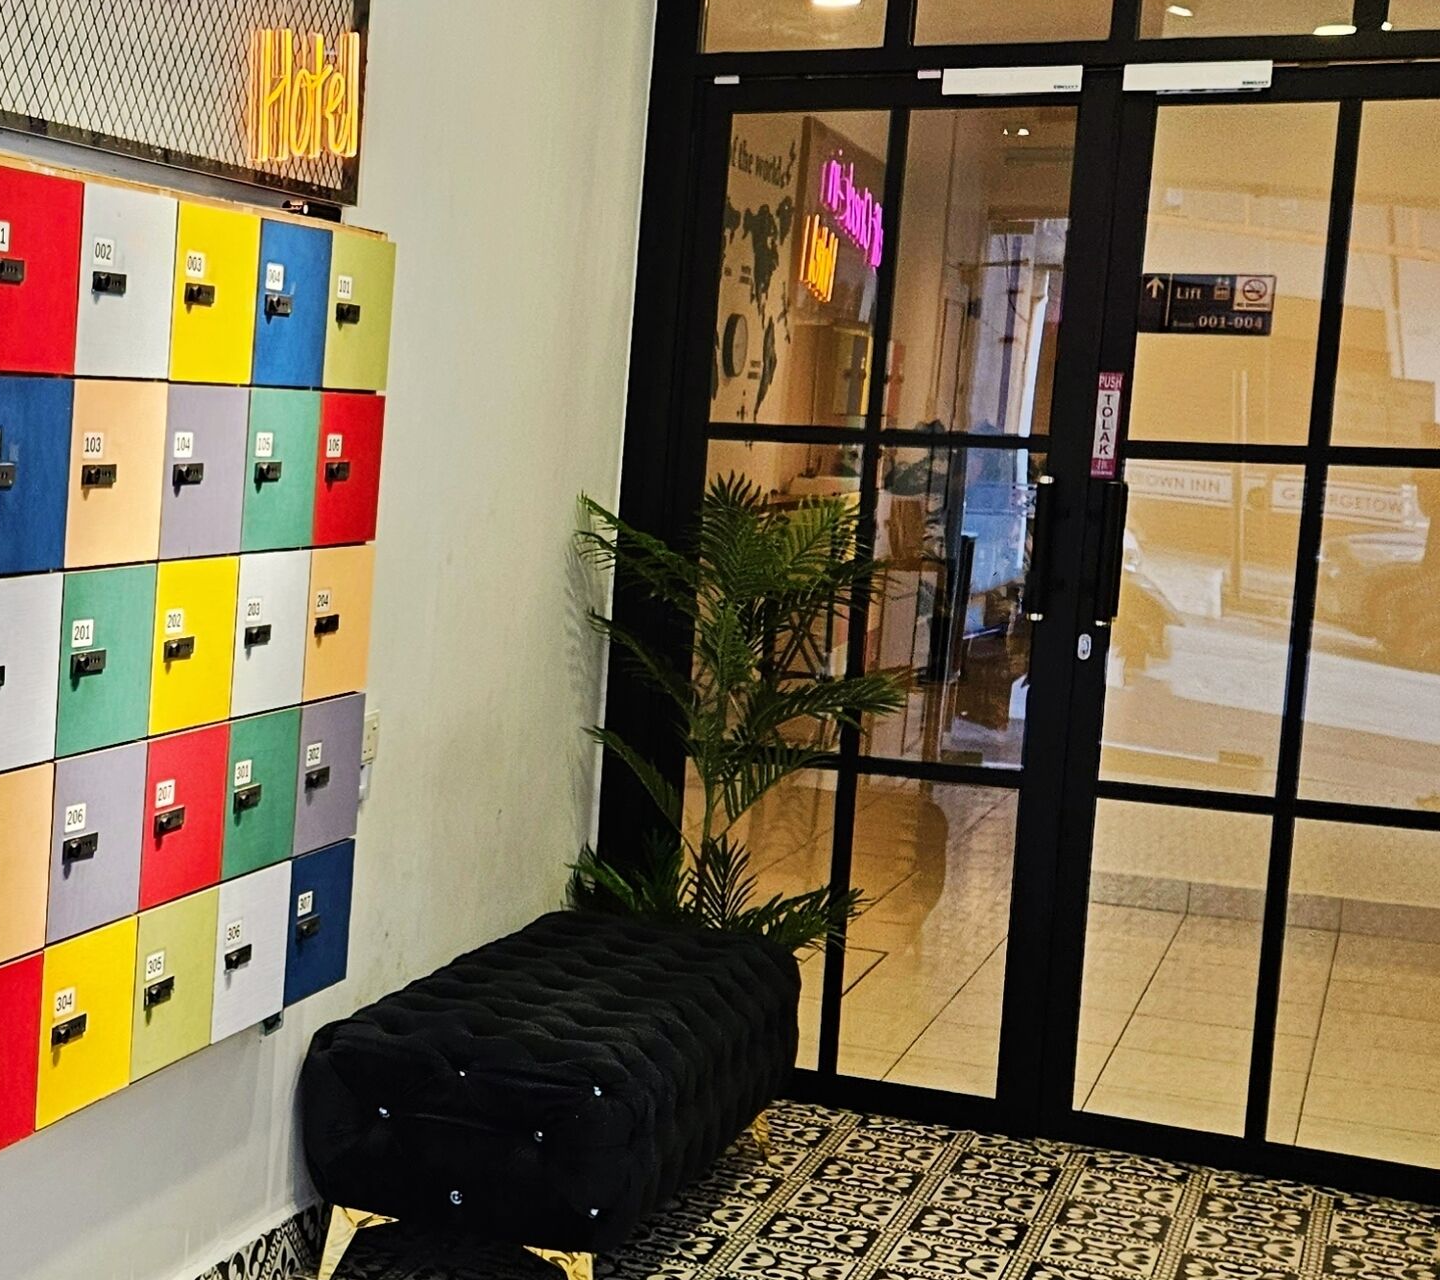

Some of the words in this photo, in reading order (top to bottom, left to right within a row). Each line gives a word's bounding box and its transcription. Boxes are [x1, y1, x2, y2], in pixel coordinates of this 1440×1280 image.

[256, 28, 359, 161] Hotel
[95, 242, 112, 261] 002
[188, 255, 202, 272] 003
[339, 279, 350, 294] 101
[1176, 287, 1201, 300] Lift
[1099, 375, 1123, 389] PUSH
[1099, 394, 1113, 455] TOLAK
[84, 437, 101, 452] 103
[176, 437, 190, 451] 104
[328, 438, 340, 452] 106
[1190, 478, 1220, 494] INN
[316, 594, 329, 608] 204
[247, 602, 260, 617] 203
[167, 613, 182, 628] 202
[74, 624, 90, 641] 201
[307, 746, 320, 761] 302
[236, 764, 249, 780] 301
[158, 784, 172, 801] 207
[67, 808, 83, 826] 206
[299, 895, 311, 911] 307
[227, 924, 240, 941] 306
[147, 956, 162, 974] 305
[56, 993, 72, 1011] 304
